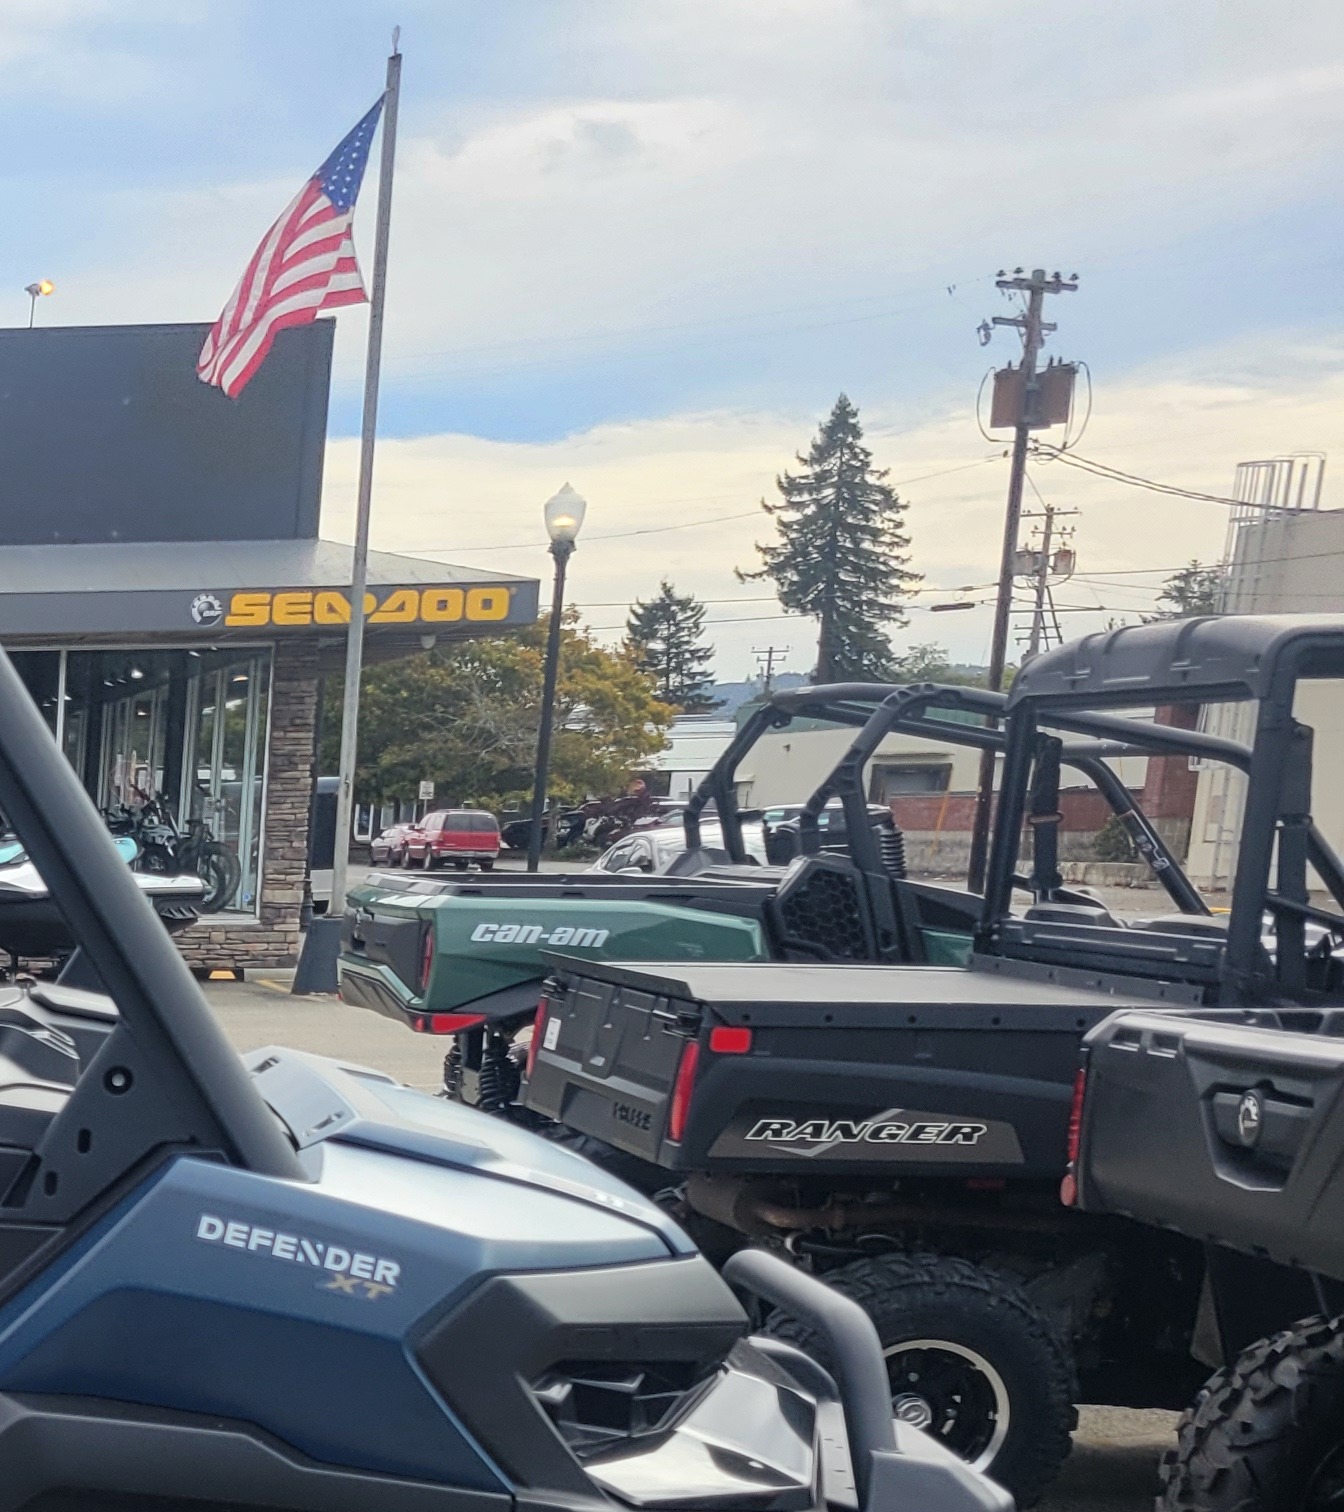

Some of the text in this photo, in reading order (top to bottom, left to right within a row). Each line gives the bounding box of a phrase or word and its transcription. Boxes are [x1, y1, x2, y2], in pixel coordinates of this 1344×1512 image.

[470, 923, 610, 948] can-am
[744, 1119, 988, 1145] RANGER
[196, 1214, 402, 1286] DEFENDER
[322, 1273, 395, 1300] XT
